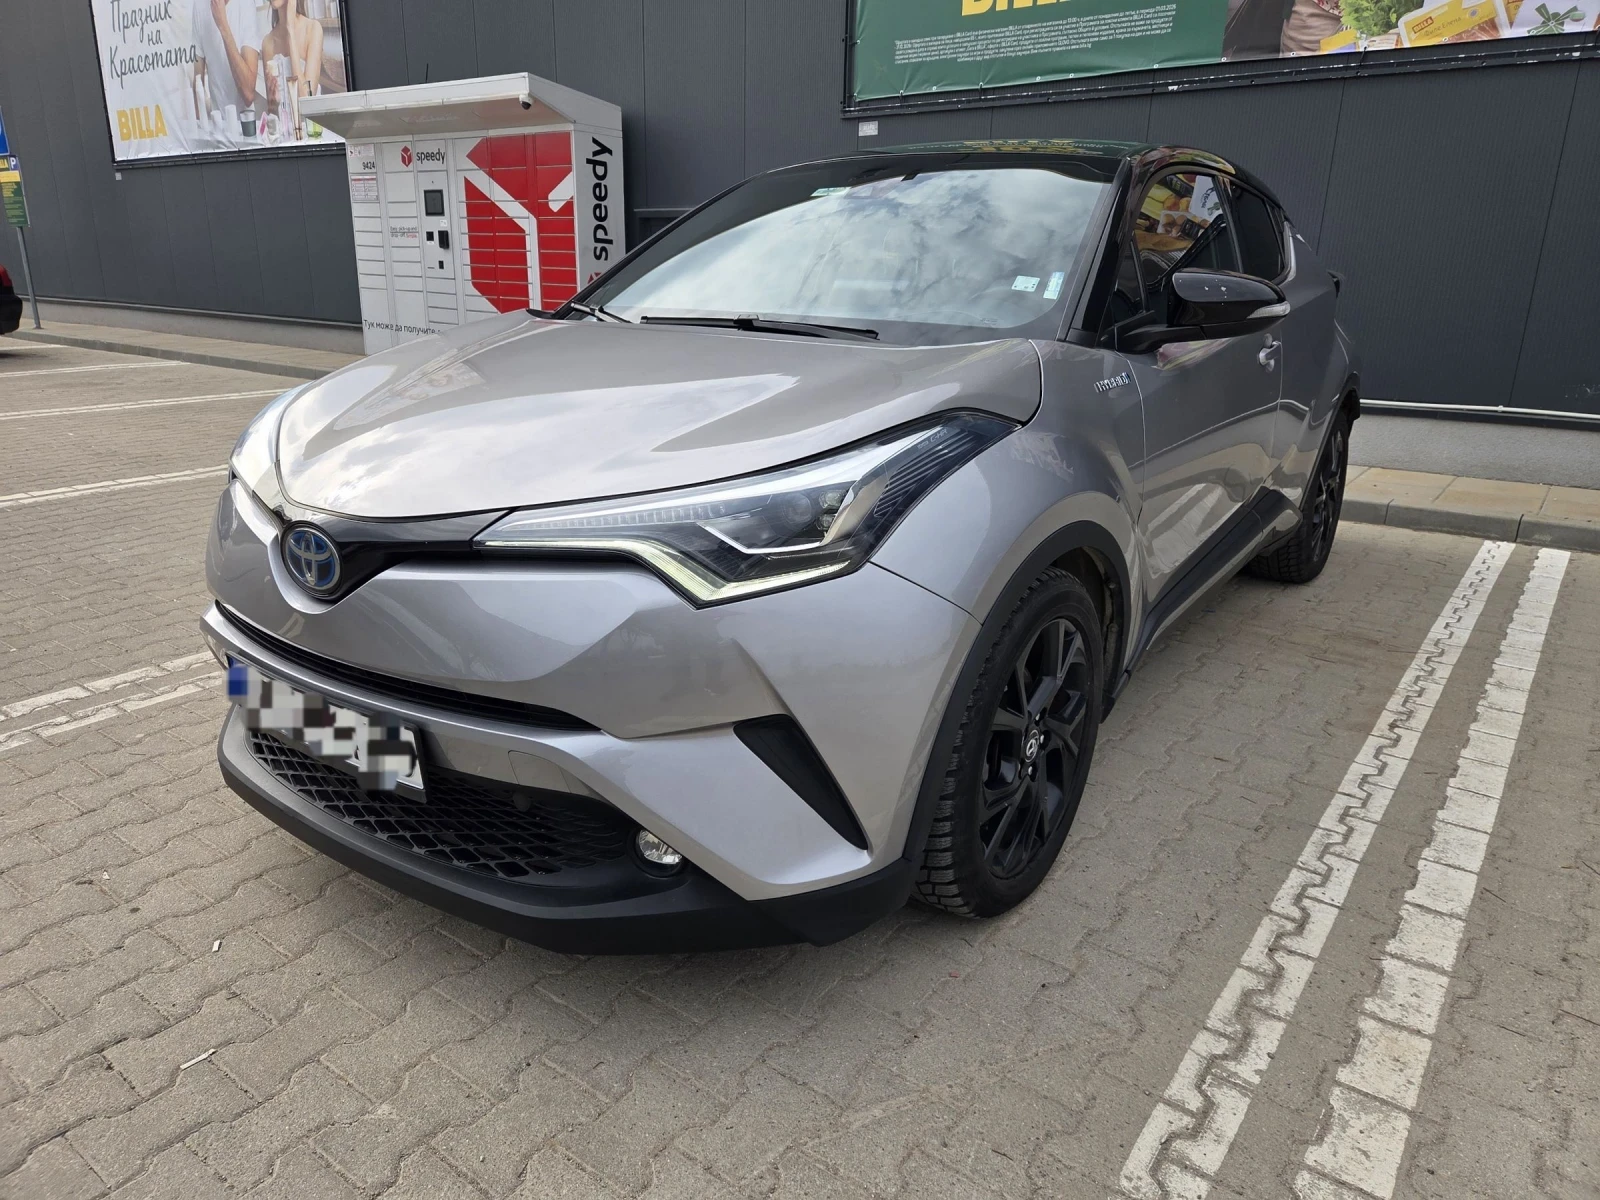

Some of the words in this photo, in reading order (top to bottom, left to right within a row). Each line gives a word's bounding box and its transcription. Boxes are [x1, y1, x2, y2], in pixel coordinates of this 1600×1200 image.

[111, 0, 172, 44] Празник
[147, 29, 163, 46] на
[110, 44, 198, 90] Красотата
[117, 104, 168, 141] BILLA
[362, 161, 376, 170] 9424
[416, 148, 445, 164] speedy
[585, 136, 613, 261] speedy
[363, 319, 375, 329] Тук
[376, 321, 394, 331] може
[395, 324, 403, 332] да
